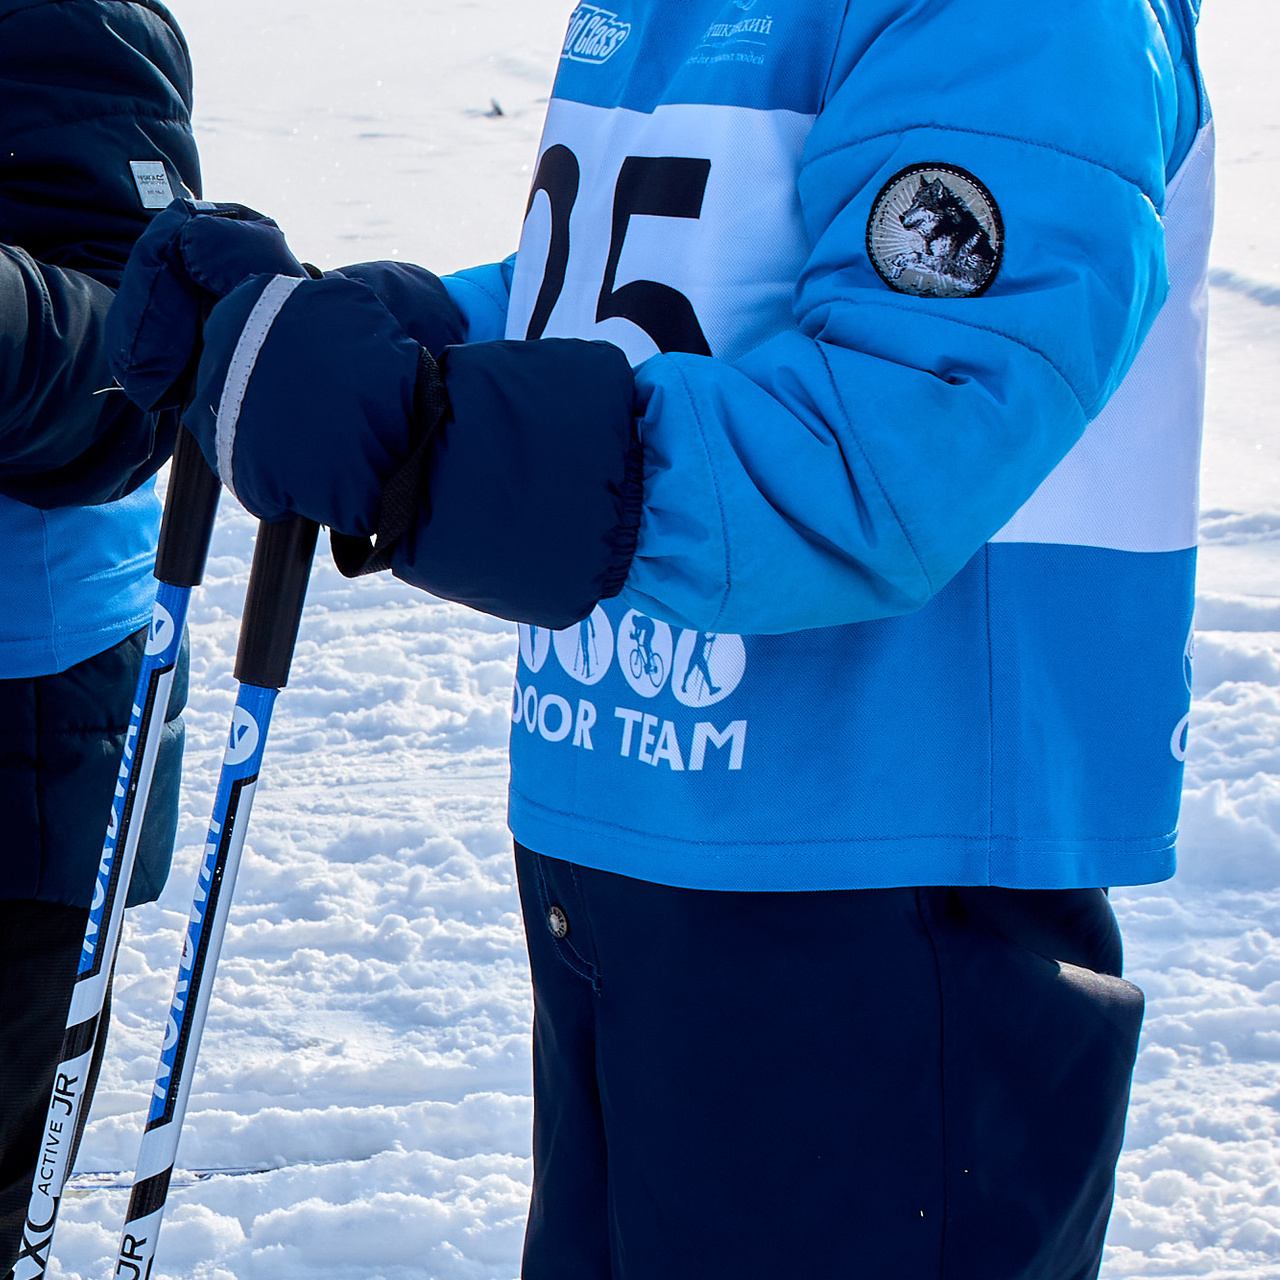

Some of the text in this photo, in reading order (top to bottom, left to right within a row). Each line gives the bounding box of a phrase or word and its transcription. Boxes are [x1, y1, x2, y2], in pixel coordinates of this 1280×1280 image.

[614, 706, 747, 772] TEAM
[37, 1119, 63, 1197] ACTIVE
[51, 1072, 79, 1117] JR
